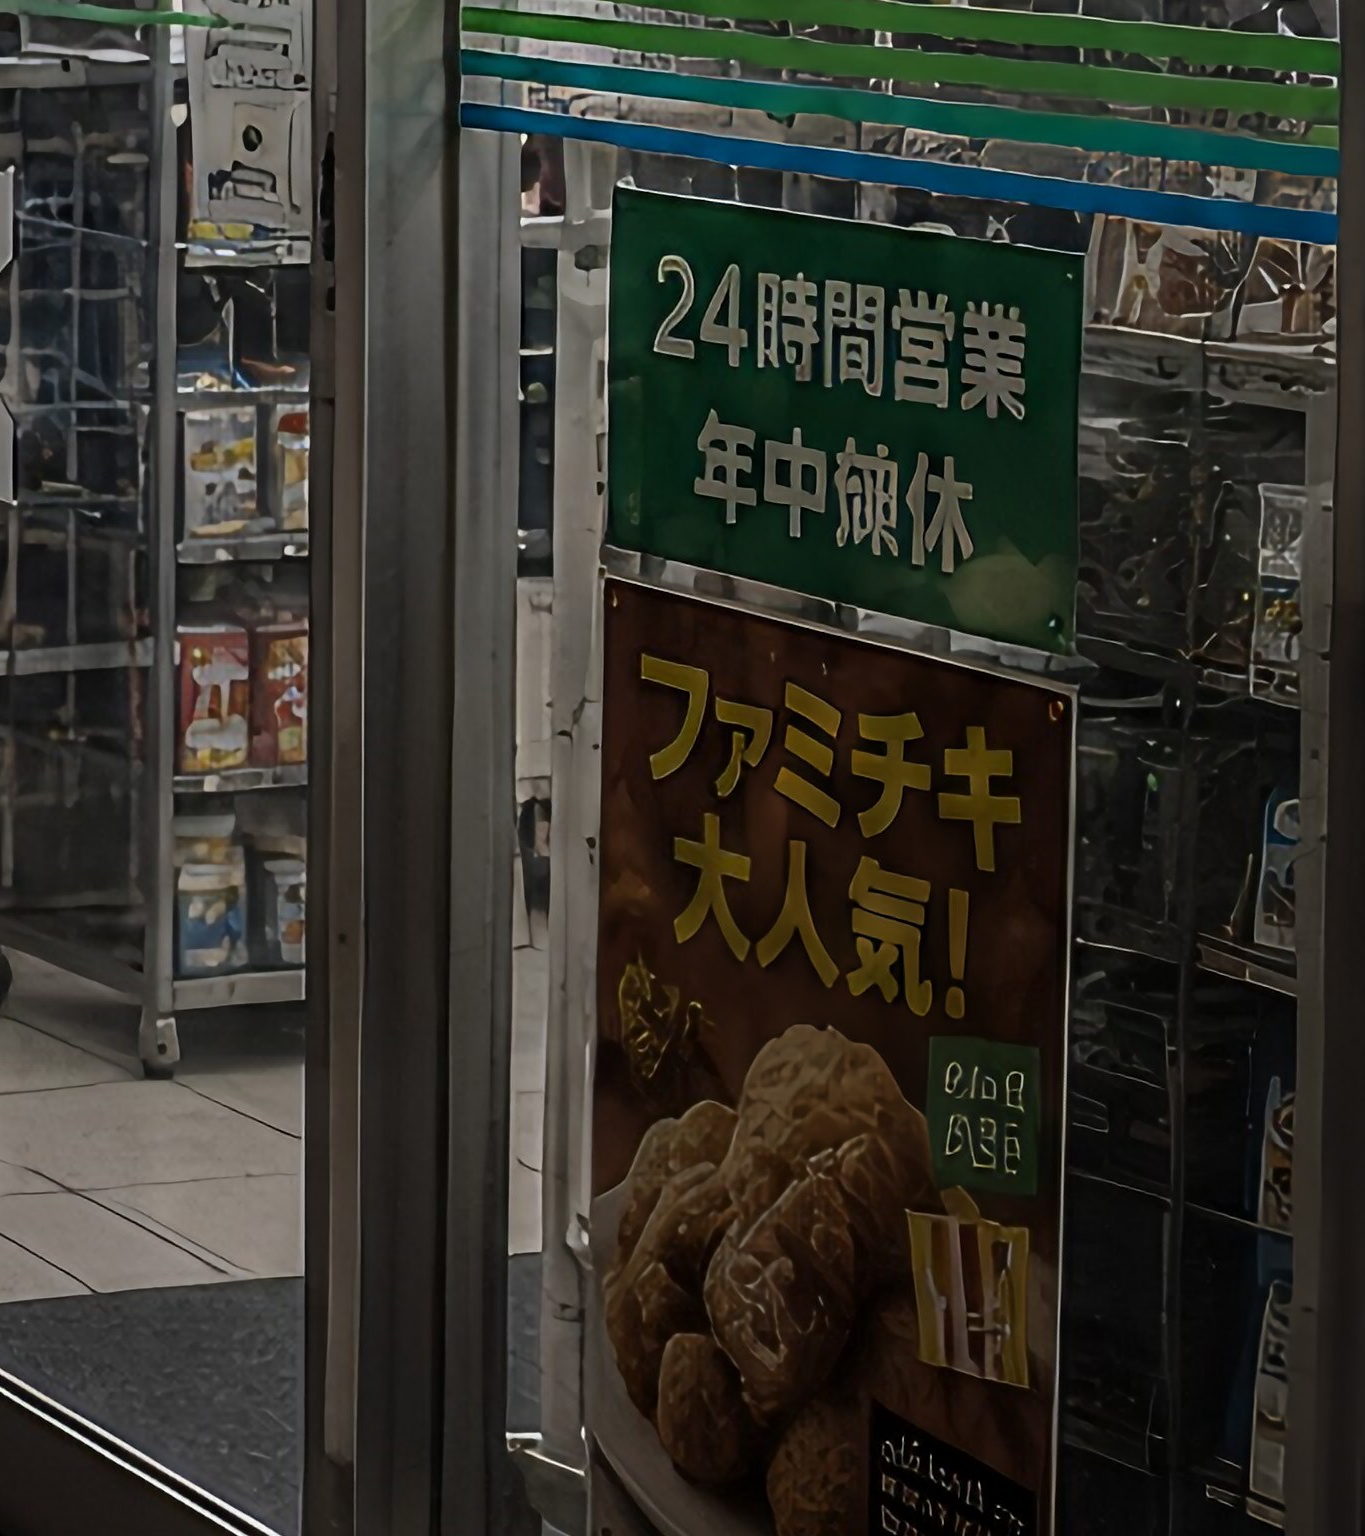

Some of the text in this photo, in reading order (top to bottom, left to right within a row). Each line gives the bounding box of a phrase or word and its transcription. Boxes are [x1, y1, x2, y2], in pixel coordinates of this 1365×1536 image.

[652, 253, 1029, 422] 24時間営業
[640, 652, 1022, 874] ファミチキ
[673, 812, 971, 1020] 大人気!
